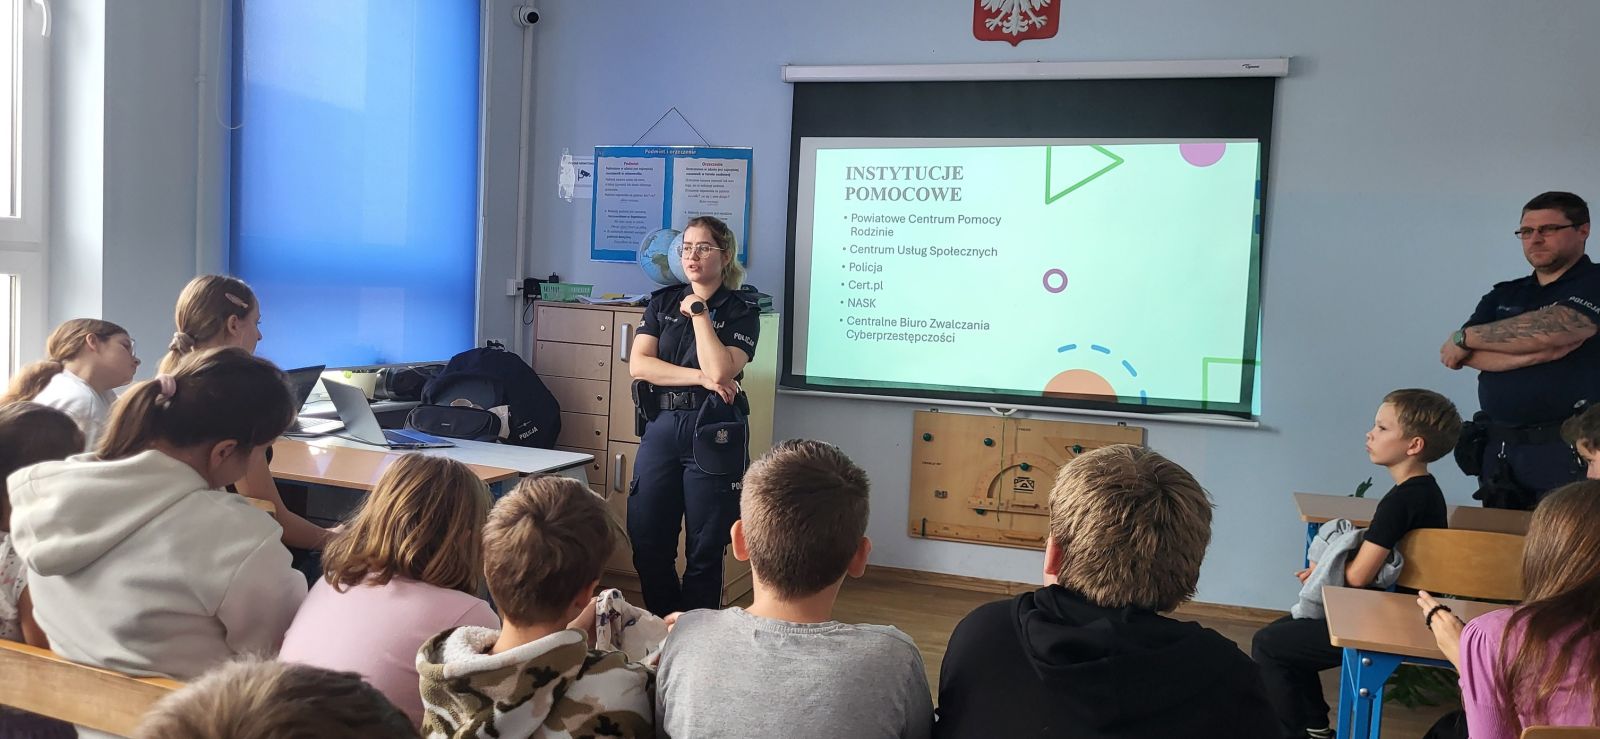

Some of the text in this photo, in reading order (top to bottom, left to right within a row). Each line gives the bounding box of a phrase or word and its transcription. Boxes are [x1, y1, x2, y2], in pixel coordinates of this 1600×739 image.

[845, 165, 964, 181] INSTYTUCJE
[844, 186, 963, 202] POMOCOWE
[851, 213, 1002, 226] Powiatowe Centrum Pomocy
[850, 226, 894, 237] Rodzinie
[849, 244, 998, 259] Centrum Usług Społecznych
[849, 262, 883, 274] Policja
[848, 280, 884, 292] Cert.pl
[847, 297, 876, 308] NASK
[1568, 296, 1600, 314] POLICJA
[846, 316, 990, 330] Centralne Biuro Zwalczania
[733, 332, 755, 347] POLICJA
[846, 329, 956, 343] Cyberprzestępczości
[519, 426, 539, 440] POLICJA
